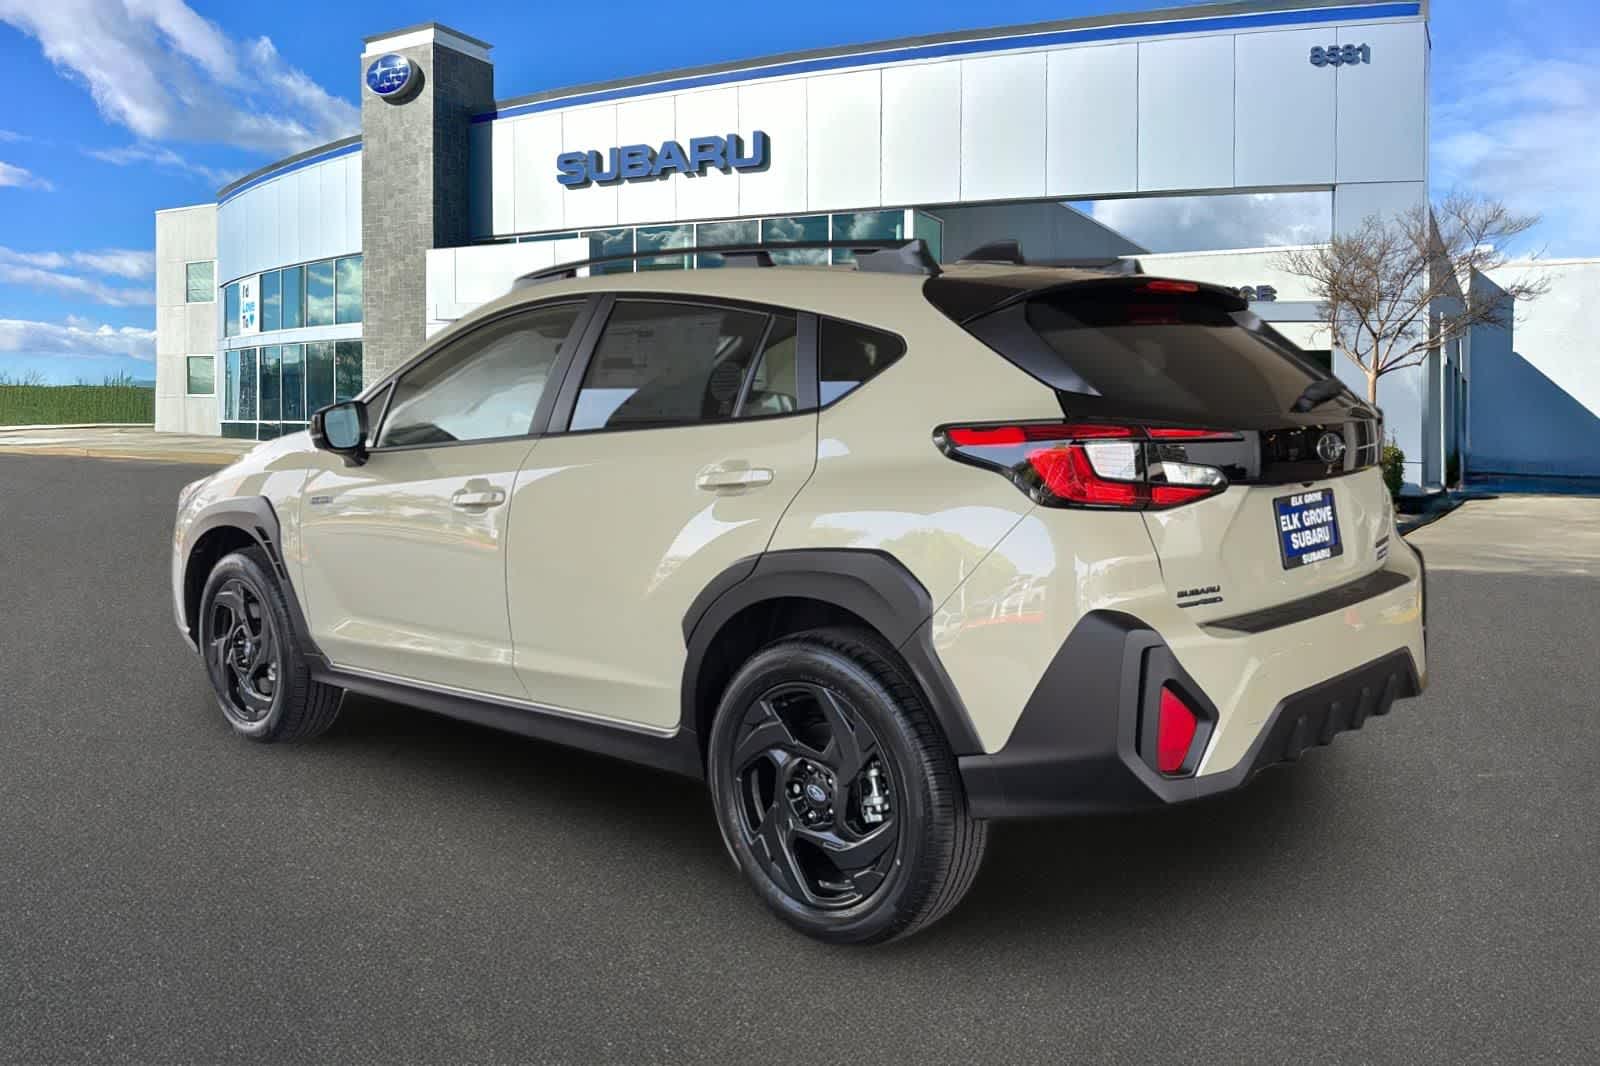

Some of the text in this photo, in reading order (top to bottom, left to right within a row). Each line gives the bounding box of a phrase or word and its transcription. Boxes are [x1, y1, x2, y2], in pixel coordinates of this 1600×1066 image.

[557, 130, 766, 187] SUBARU
[1291, 491, 1323, 507] ELK GROVE
[1280, 506, 1333, 532] ELK GROVE
[1291, 526, 1330, 550] SUBARU
[1302, 548, 1331, 564] SUBARU
[1177, 584, 1220, 598] SUBARU
